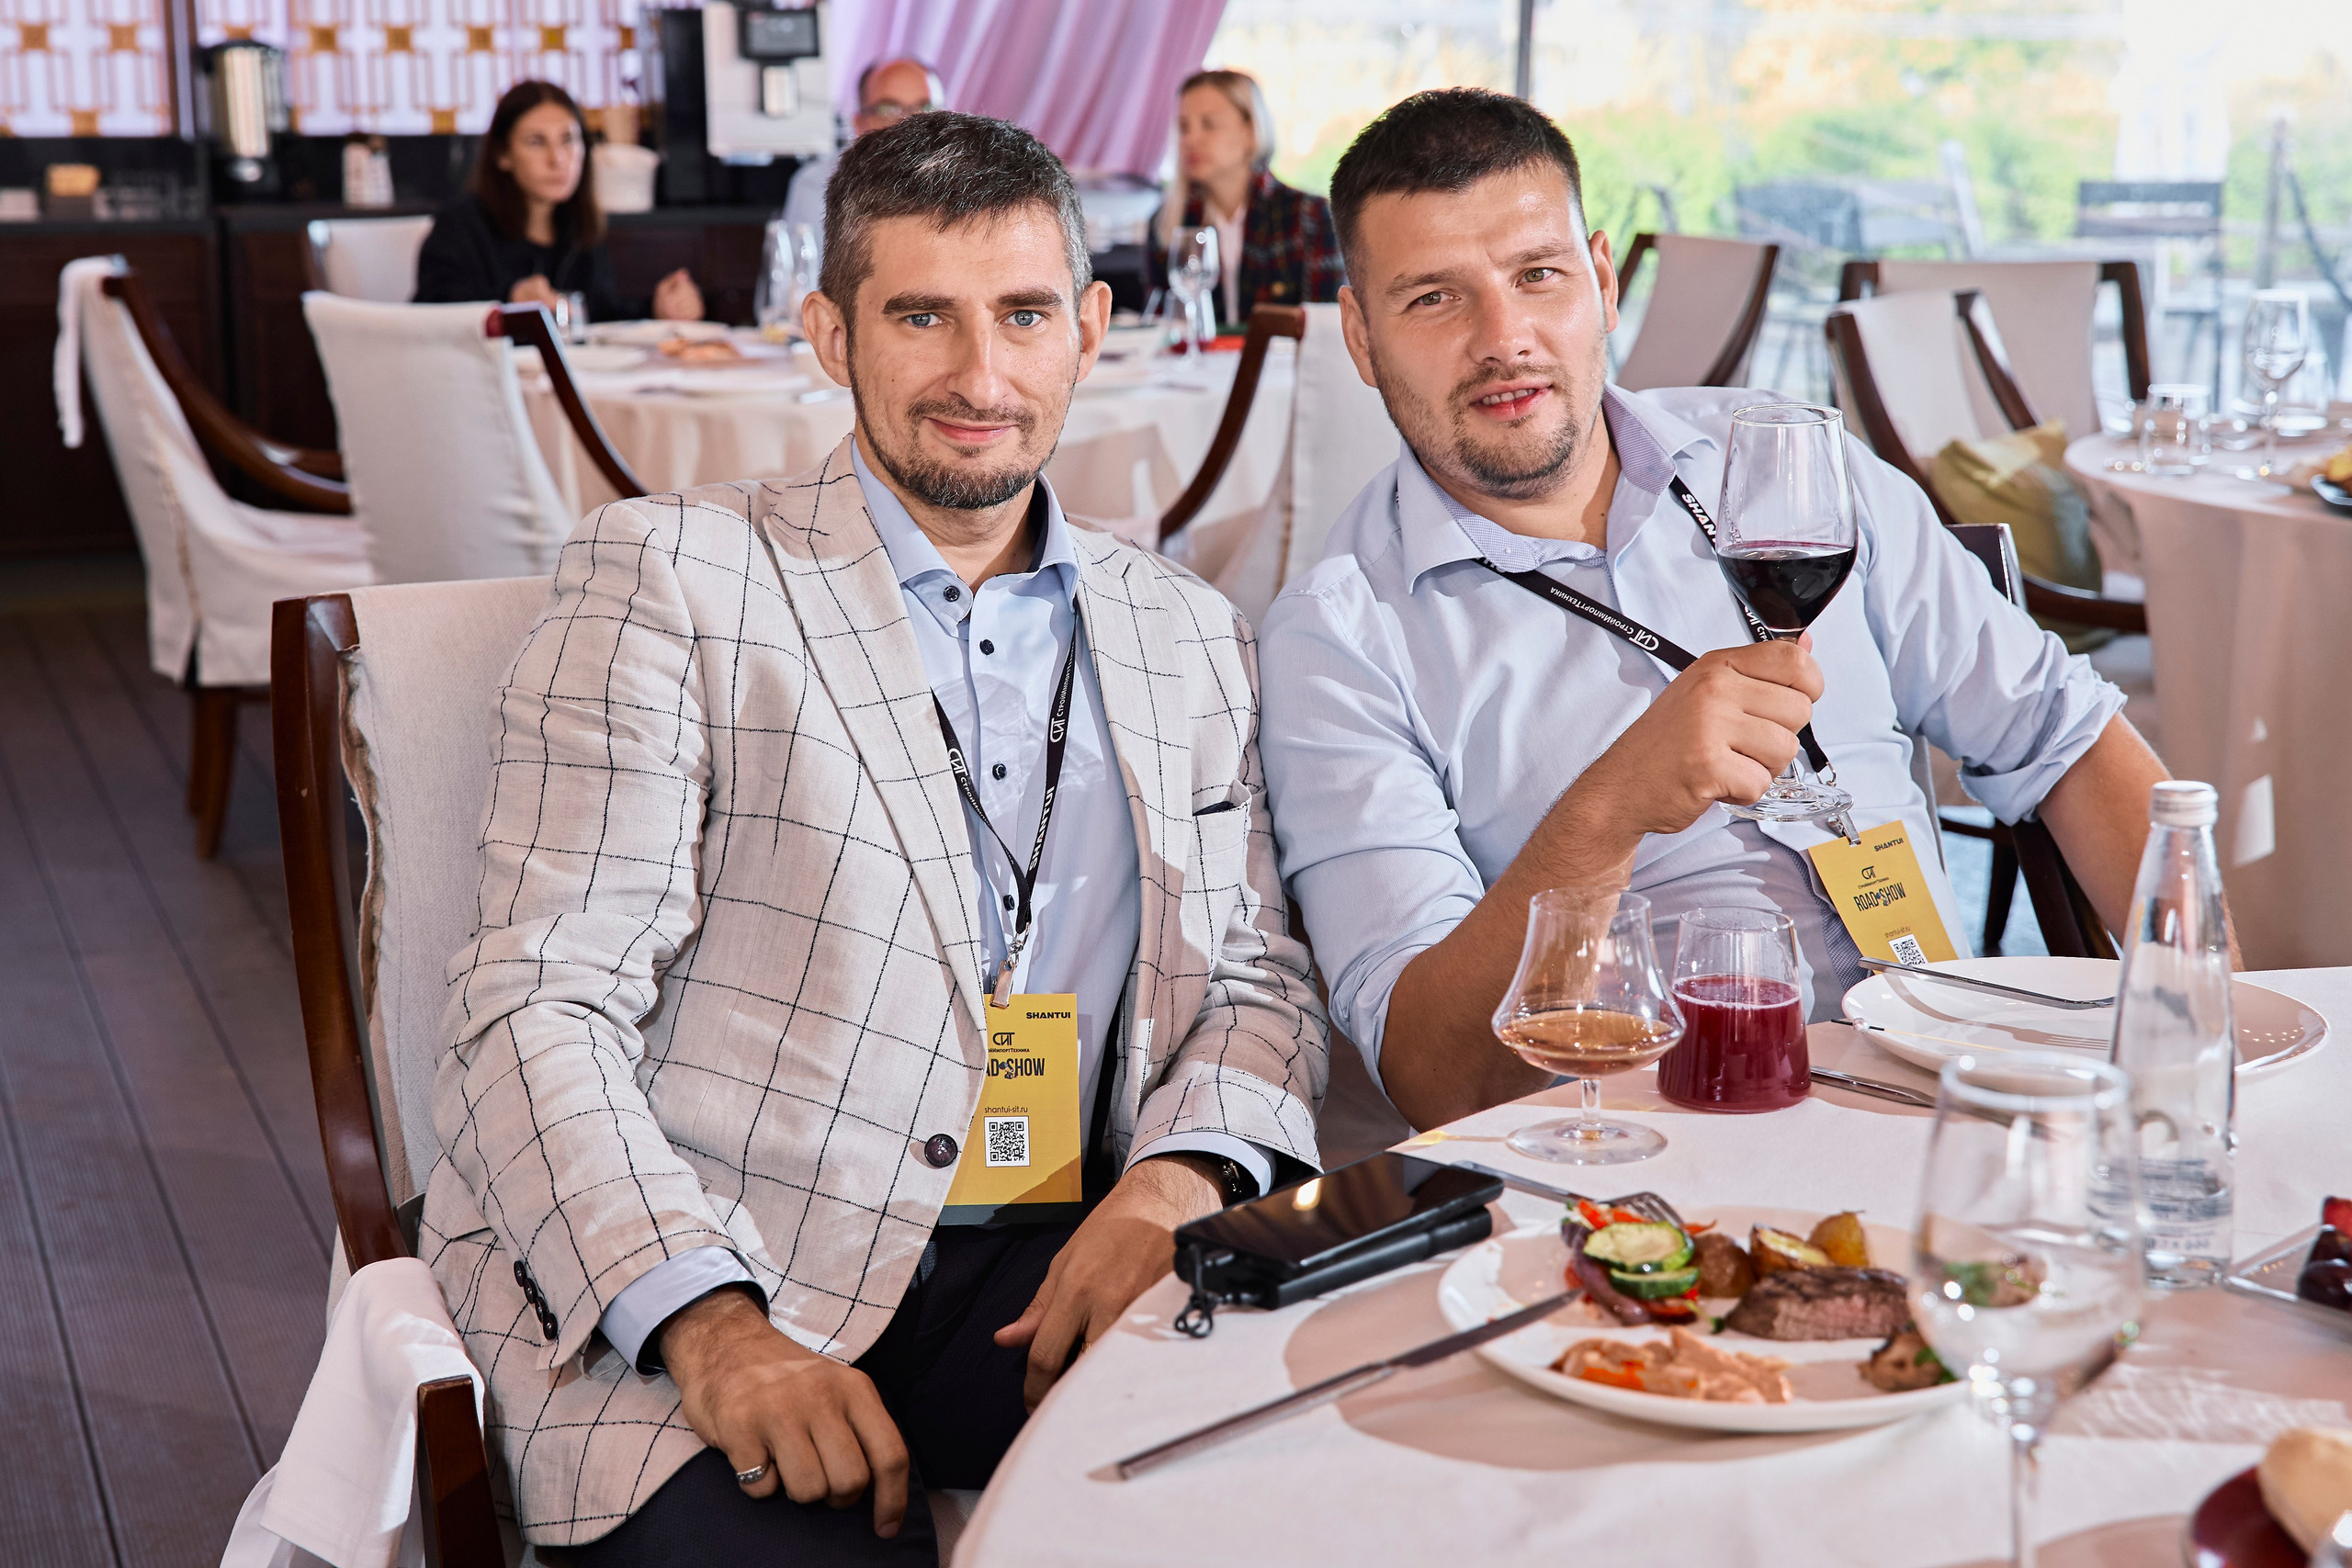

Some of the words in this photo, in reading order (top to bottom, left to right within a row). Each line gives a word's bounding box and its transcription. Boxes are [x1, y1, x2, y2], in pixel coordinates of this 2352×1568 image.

[1029, 785, 1056, 871] SHANTUI
[1873, 837, 1905, 852] SHANTUI
[1853, 890, 1880, 912] ROAD
[1879, 882, 1906, 905] SHOW
[1025, 1011, 1071, 1020] SHANTUI
[1007, 1057, 1046, 1077] SHOW
[984, 1105, 1029, 1113] shantui-sit.ru
